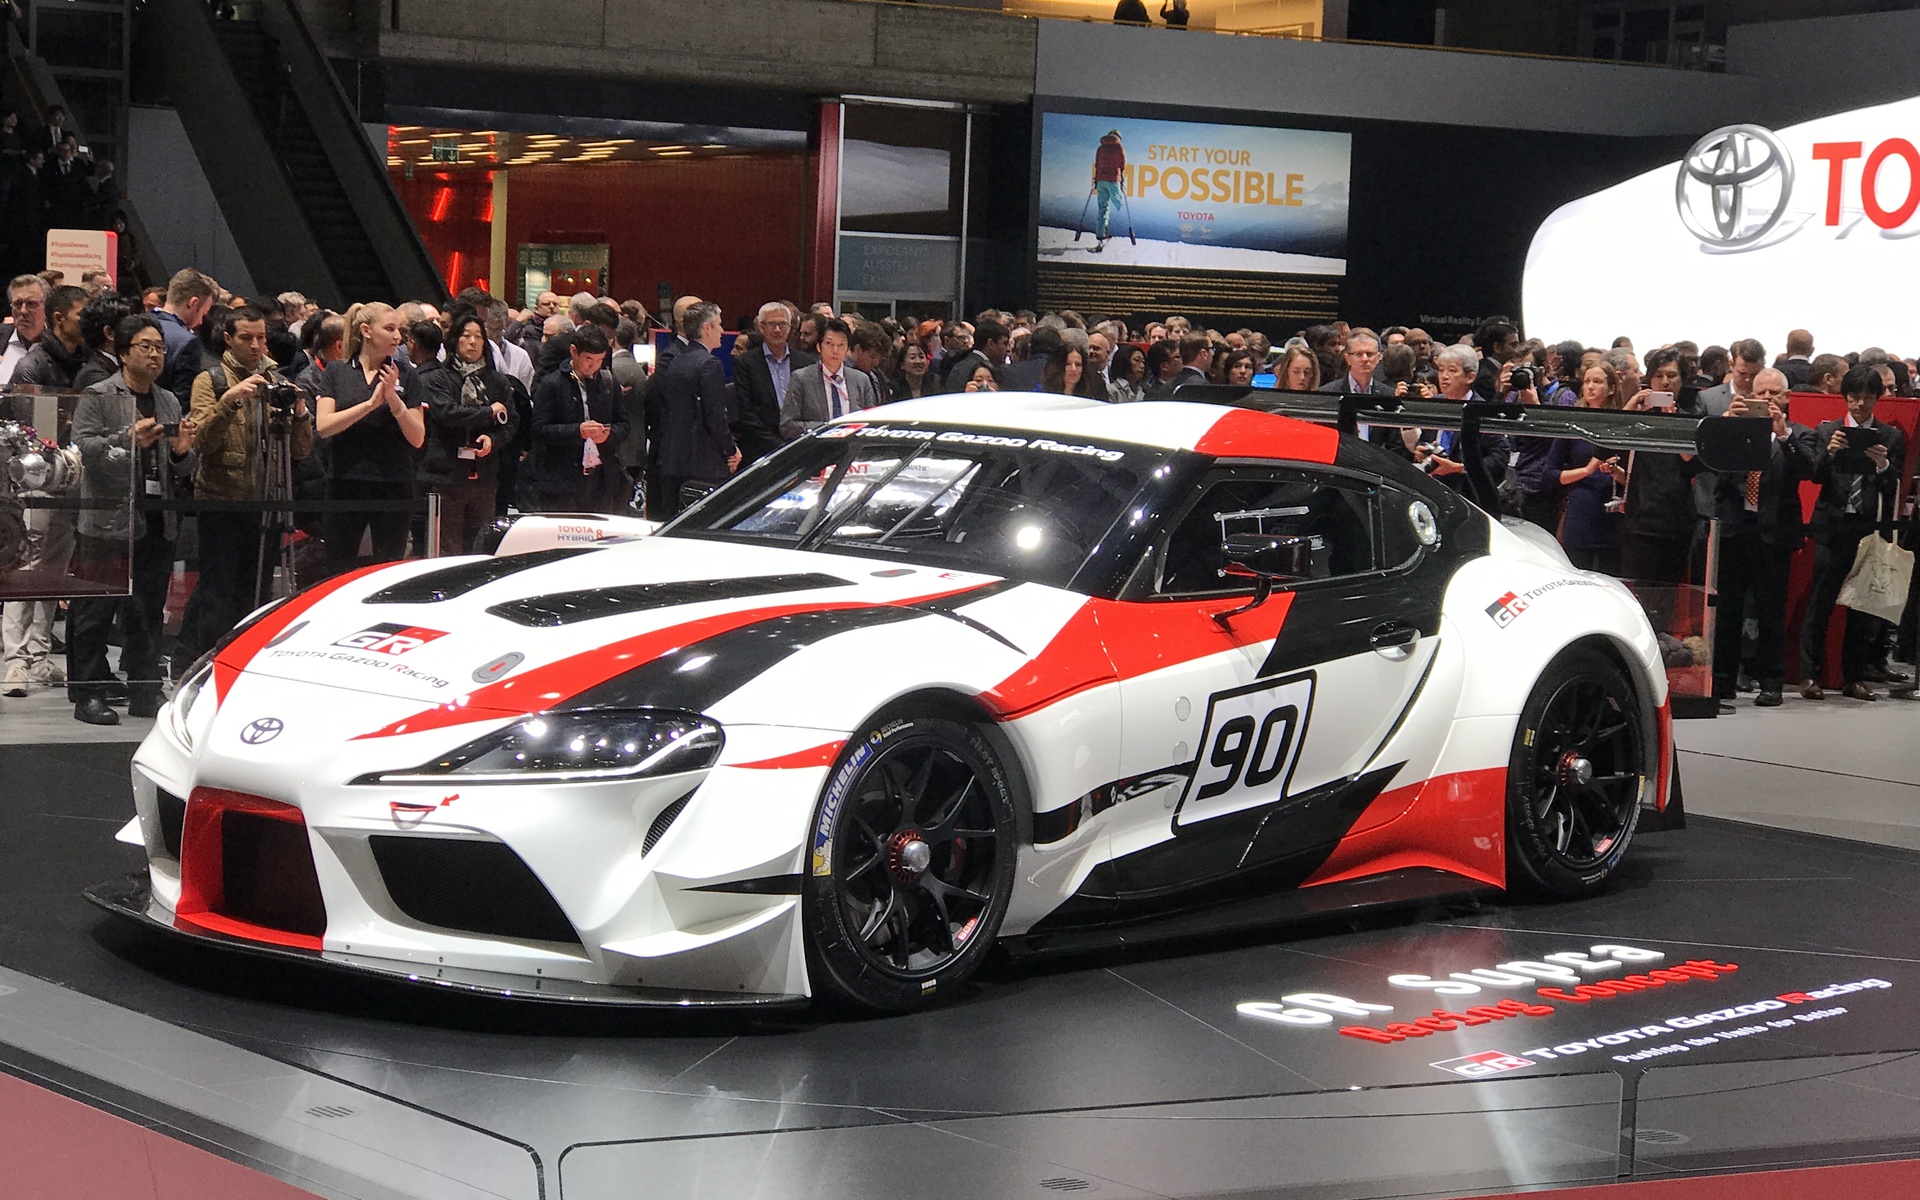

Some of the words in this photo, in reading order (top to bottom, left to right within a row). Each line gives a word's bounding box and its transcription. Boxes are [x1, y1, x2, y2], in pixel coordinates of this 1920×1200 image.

[1148, 145, 1199, 162] START
[1205, 148, 1251, 166] YOUR
[1812, 137, 1920, 230] TO
[1177, 211, 1215, 221] TOYOTA
[1420, 314, 1447, 325] Virtual
[1448, 316, 1476, 327] Reality
[855, 427, 937, 440] TOYOTA
[1028, 439, 1125, 462] Racing
[557, 525, 594, 533] TOYOTA
[596, 529, 603, 539] 8
[1493, 597, 1527, 629] GR
[1522, 579, 1567, 600] TOYOTA
[337, 631, 426, 656] GR
[269, 650, 328, 659] TOYOTA
[389, 663, 450, 689] Racing
[1195, 704, 1299, 801] 90
[819, 742, 868, 837] MICHELIN
[1235, 992, 1396, 1027] GR
[1387, 943, 1666, 996] Supra
[1338, 997, 1556, 1045] Racing
[1536, 958, 1740, 1003] Concept
[1454, 1057, 1527, 1077] GR
[1520, 1025, 1675, 1060] TOYOTA
[1775, 977, 1894, 1004] Racing
[1611, 1043, 1691, 1064] Pushing
[1683, 1035, 1720, 1047] the
